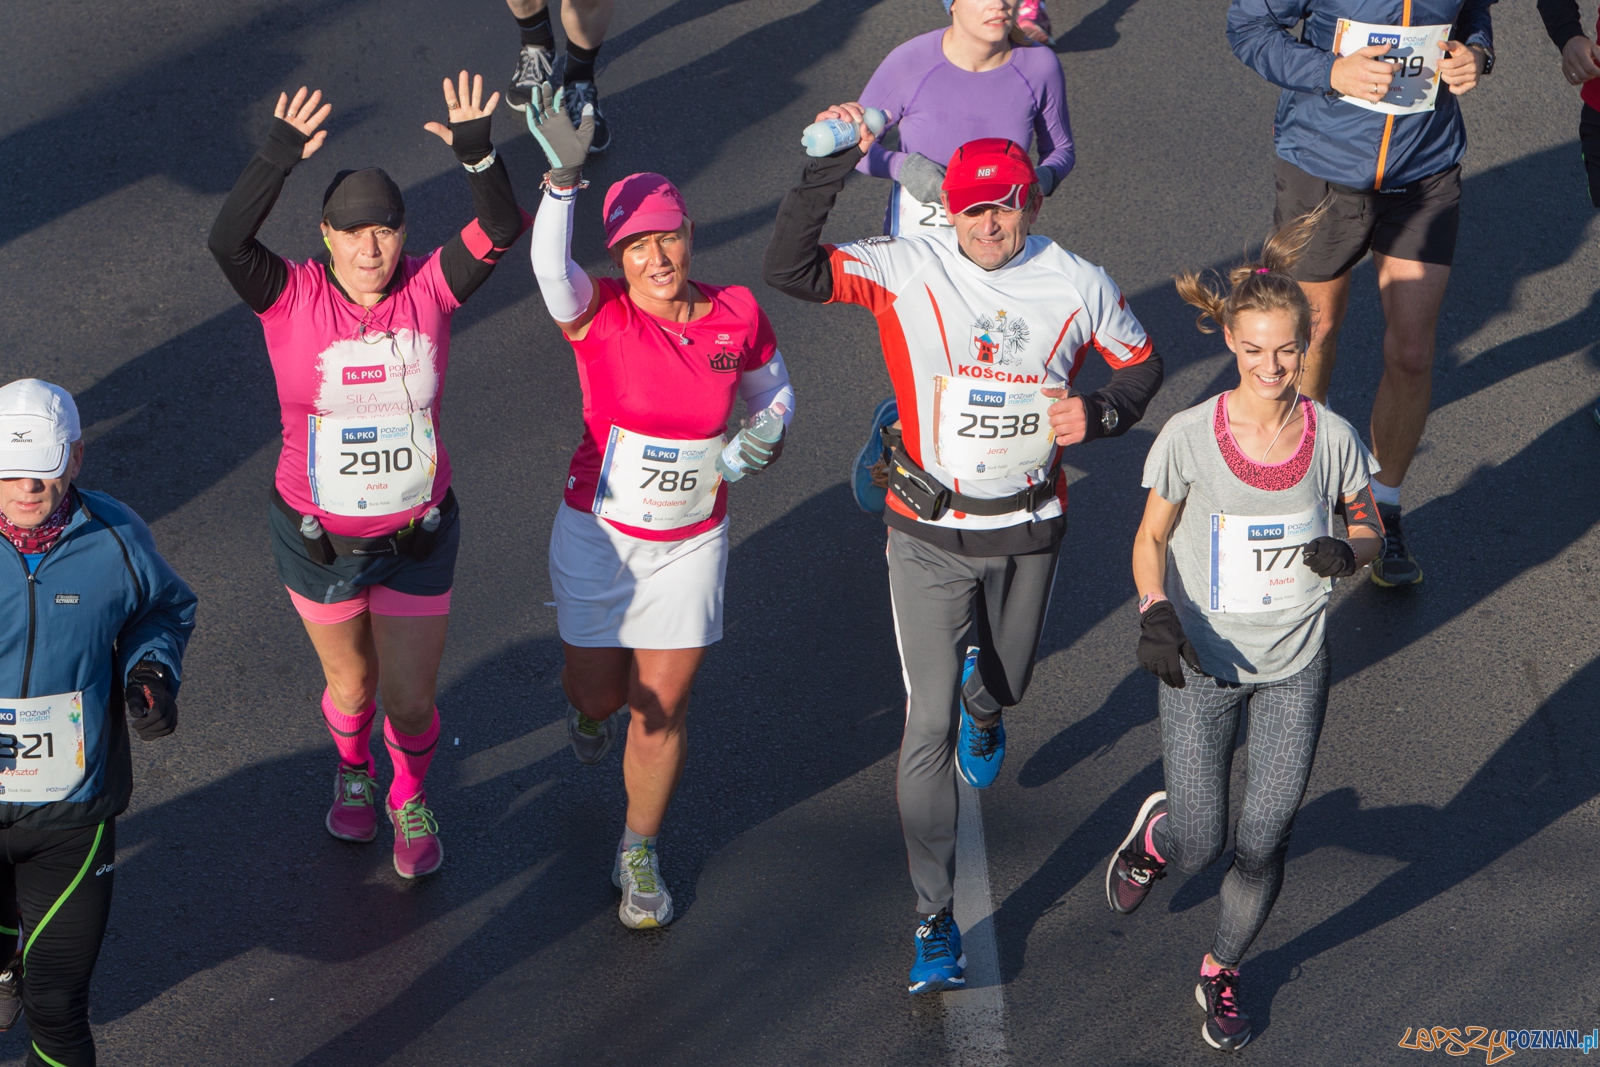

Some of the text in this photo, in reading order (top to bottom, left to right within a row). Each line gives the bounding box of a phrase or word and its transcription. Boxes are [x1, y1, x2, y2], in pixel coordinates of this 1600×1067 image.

[1381, 37, 1398, 45] PKO
[345, 369, 383, 380] 16. PKO
[958, 364, 1039, 384] KOŚCIAN
[346, 393, 378, 405] SIŁA
[972, 393, 1003, 404] 16. PKO
[1008, 397, 1035, 405] maraton
[957, 412, 1040, 439] 2538
[344, 431, 375, 440] 16. PKO
[380, 431, 408, 439] maraton
[646, 449, 676, 460] 16. PKO
[987, 447, 1009, 455] Jerzy
[339, 447, 413, 475] 2910
[639, 466, 699, 492] 786
[366, 483, 389, 491] Anita
[642, 498, 687, 507] Magdalena
[1251, 528, 1282, 537] 16. PKO
[1252, 542, 1308, 572] 177
[1269, 577, 1295, 586] Marta
[19, 714, 51, 723] maraton
